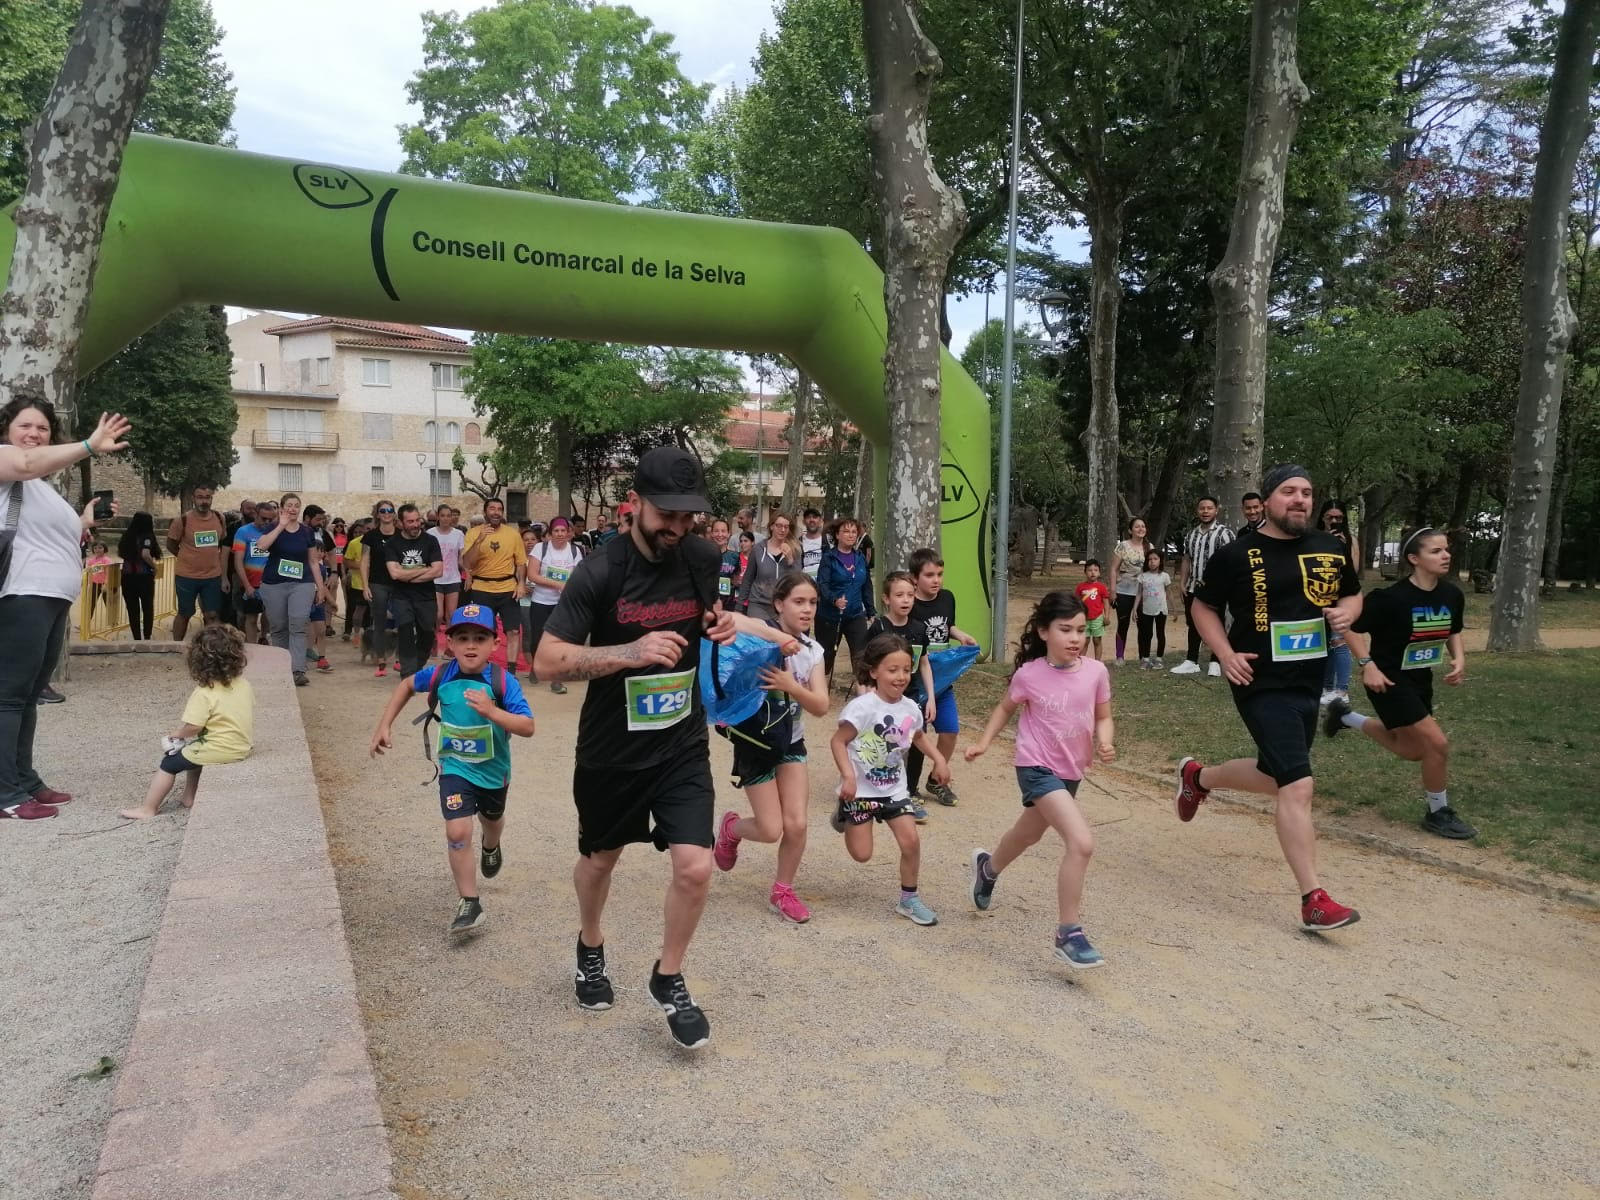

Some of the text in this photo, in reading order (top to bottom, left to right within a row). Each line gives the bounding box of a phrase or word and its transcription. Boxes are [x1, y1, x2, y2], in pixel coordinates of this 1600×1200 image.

[309, 174, 349, 192] SLV
[412, 230, 747, 287] Consell Comarcal de la Selva
[941, 485, 965, 502] LV
[1247, 548, 1269, 632] C.E. VACARISSES
[1411, 605, 1452, 622] FILA
[1289, 633, 1314, 649] 77
[1415, 648, 1433, 661] 58
[642, 690, 688, 714] 129
[450, 738, 477, 753] 92
